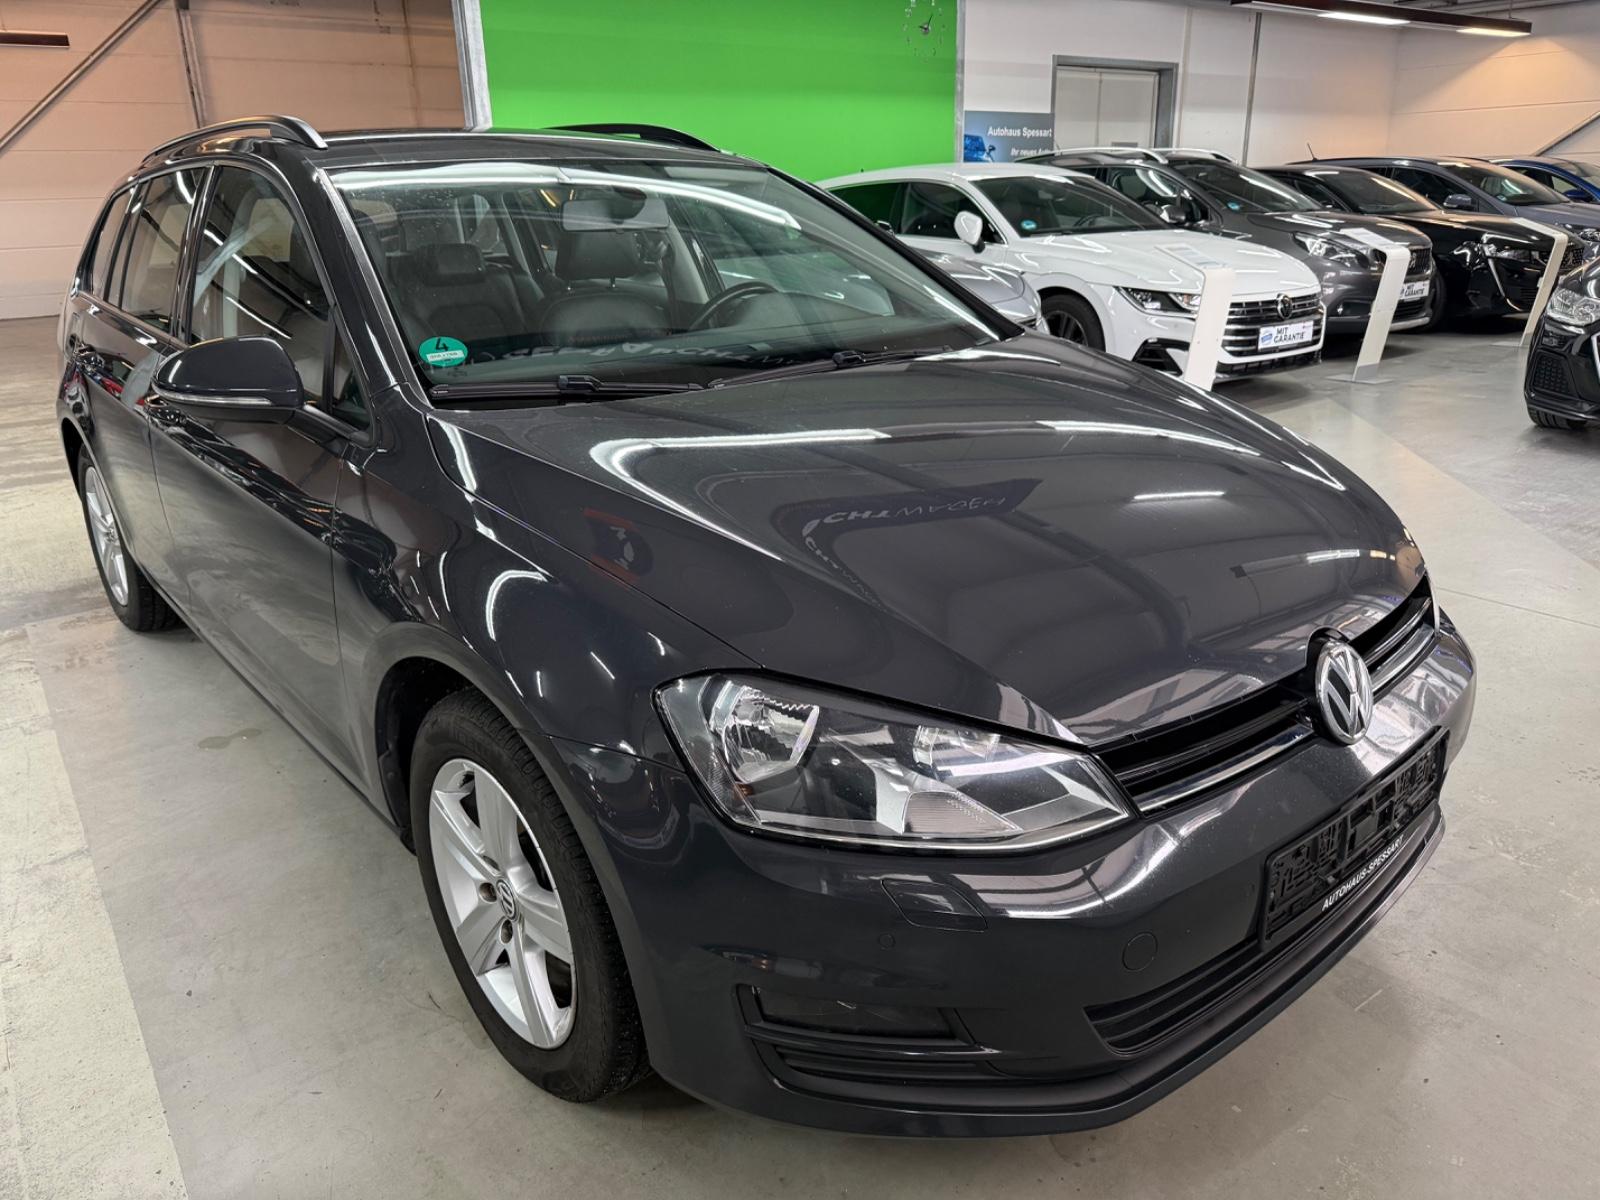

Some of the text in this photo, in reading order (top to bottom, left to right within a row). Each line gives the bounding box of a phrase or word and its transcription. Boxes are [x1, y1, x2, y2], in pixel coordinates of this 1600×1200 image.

[987, 126, 1052, 139] Autohaus Spessart
[1273, 331, 1305, 343] GARANTIE
[1276, 327, 1289, 335] MIT
[435, 337, 449, 351] 4
[1321, 833, 1404, 912] AUTOHAUS-SPESSART
